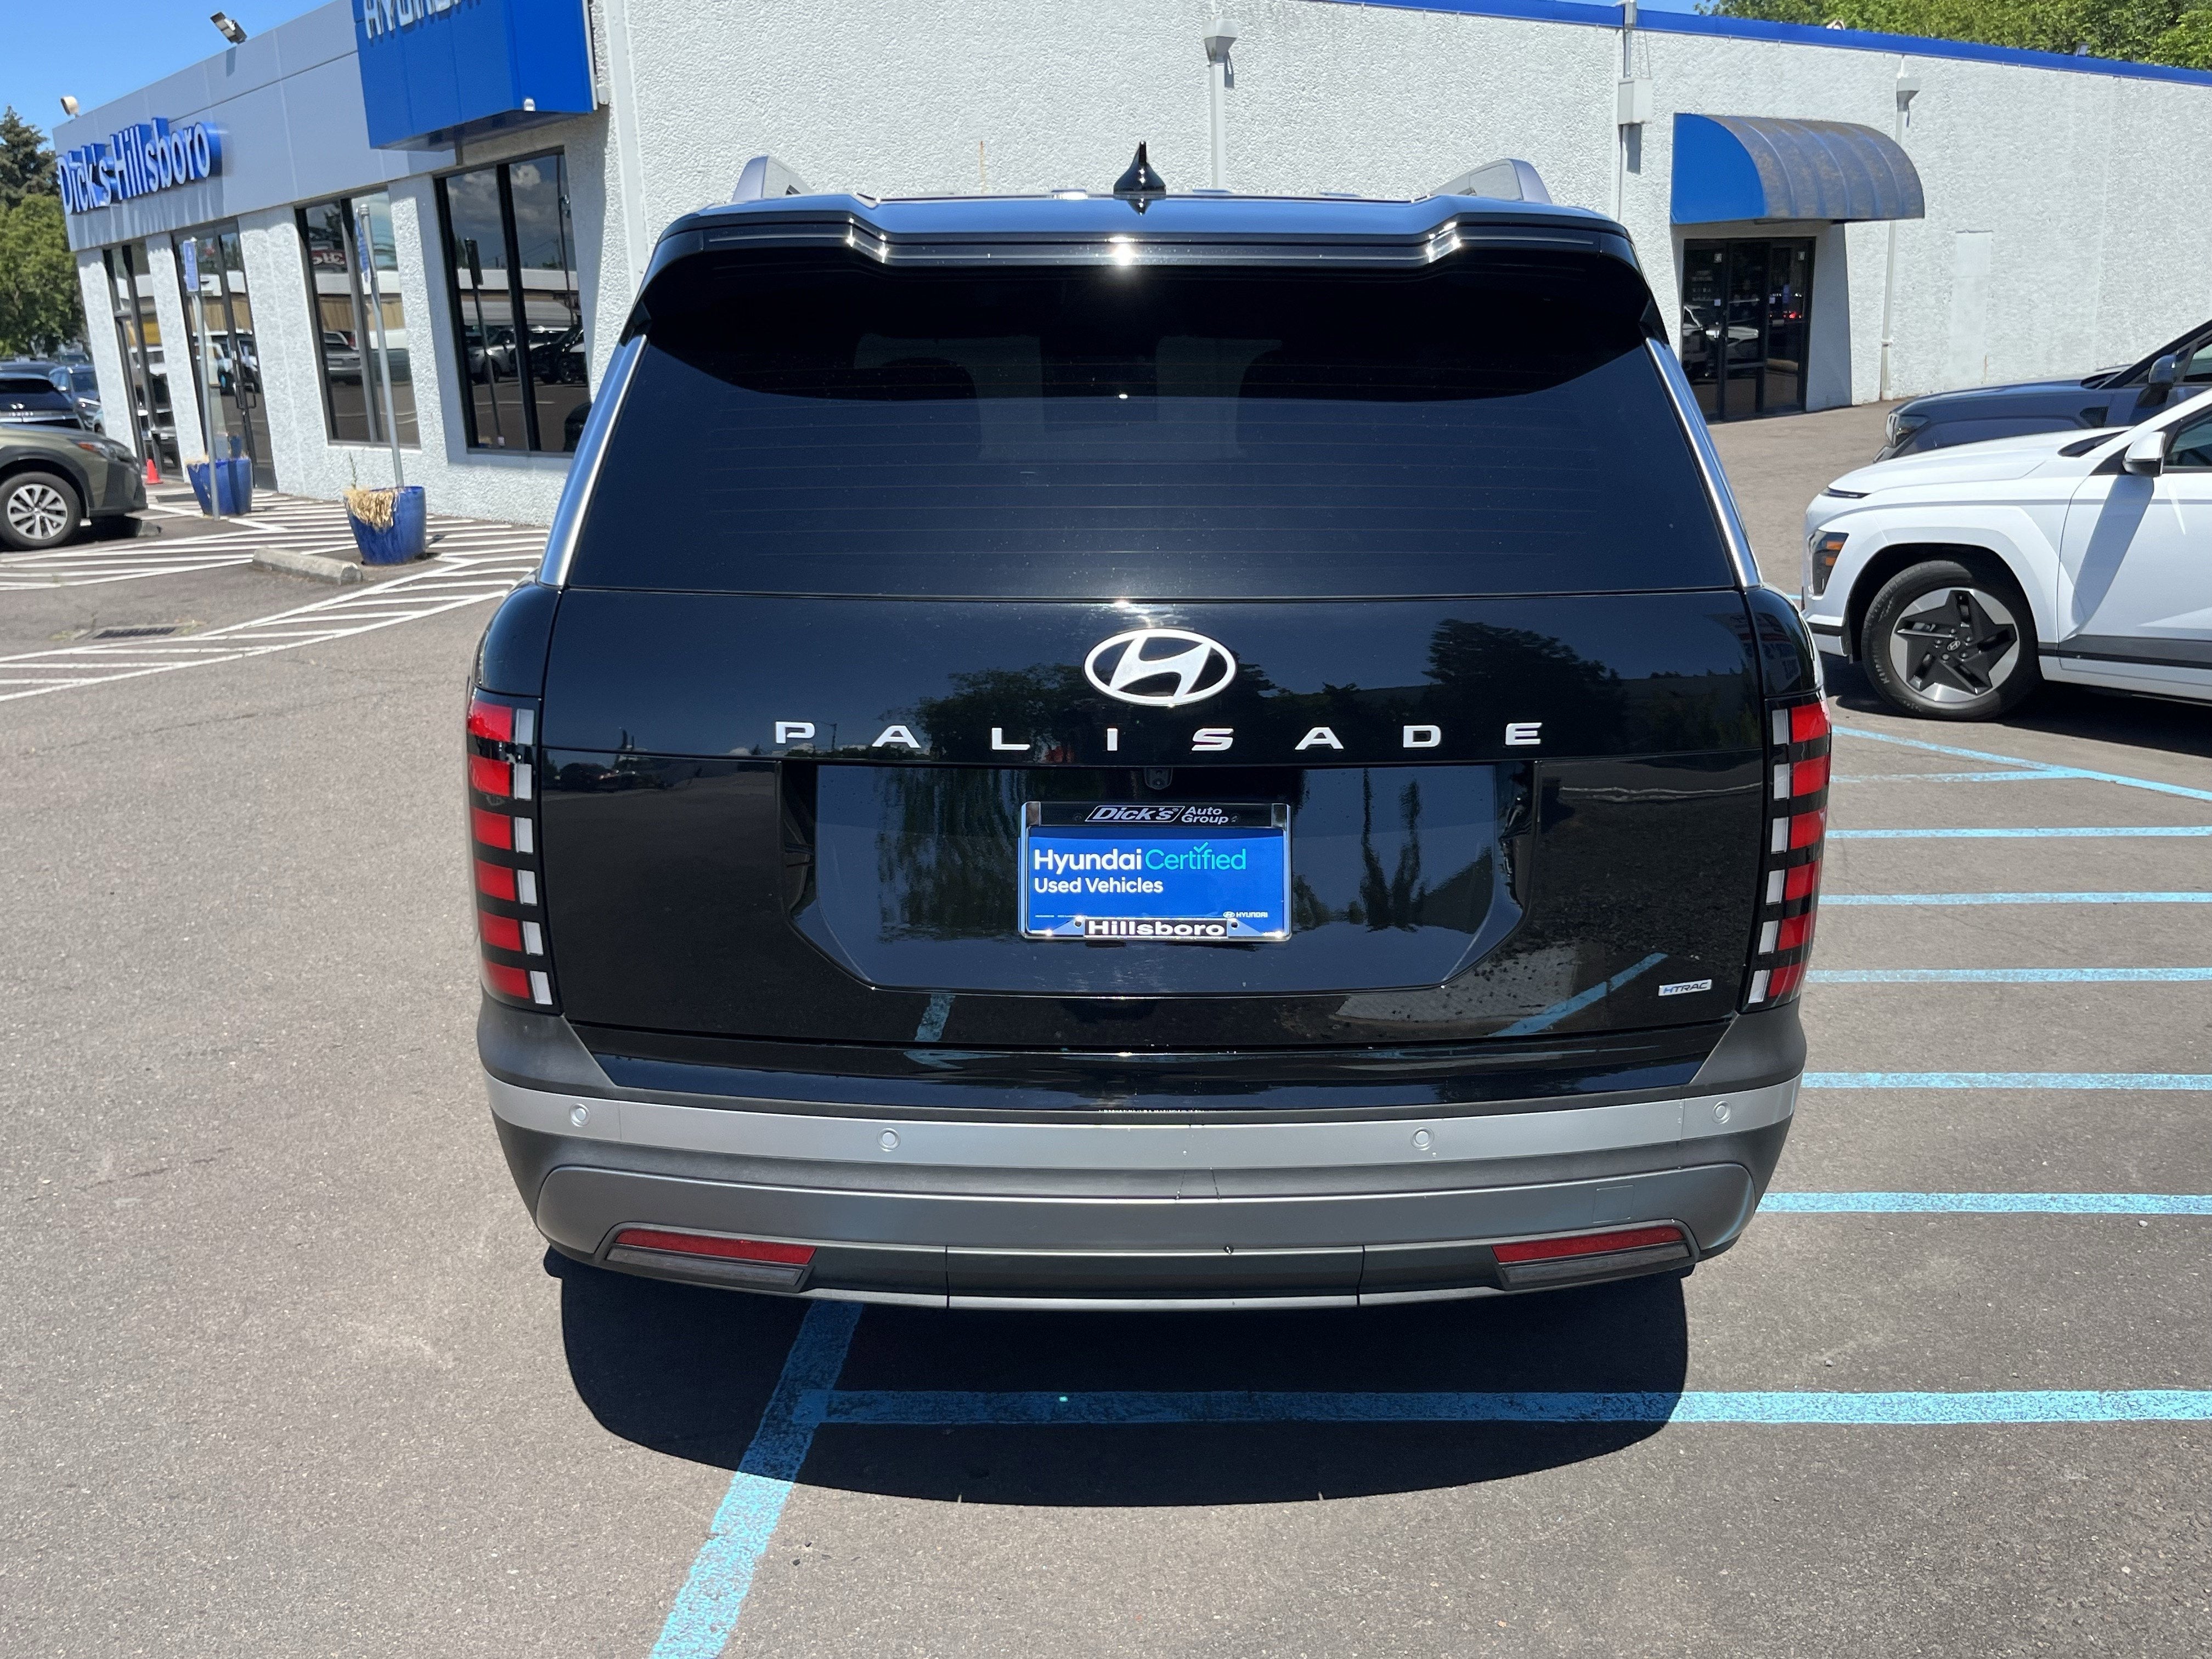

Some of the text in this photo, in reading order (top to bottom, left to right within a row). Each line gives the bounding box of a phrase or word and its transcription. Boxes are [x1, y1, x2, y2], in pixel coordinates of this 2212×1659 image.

[56, 119, 211, 215] Dick's Hillsboro
[775, 721, 1544, 752] PALISADE
[1184, 806, 1222, 815] Auto
[1181, 814, 1229, 825] Group
[1034, 847, 1247, 874] Hyundai Certified
[1035, 877, 1164, 893] Used Vehicles
[1087, 921, 1226, 936] Hillsboro
[1663, 981, 1708, 994] HTRAC
